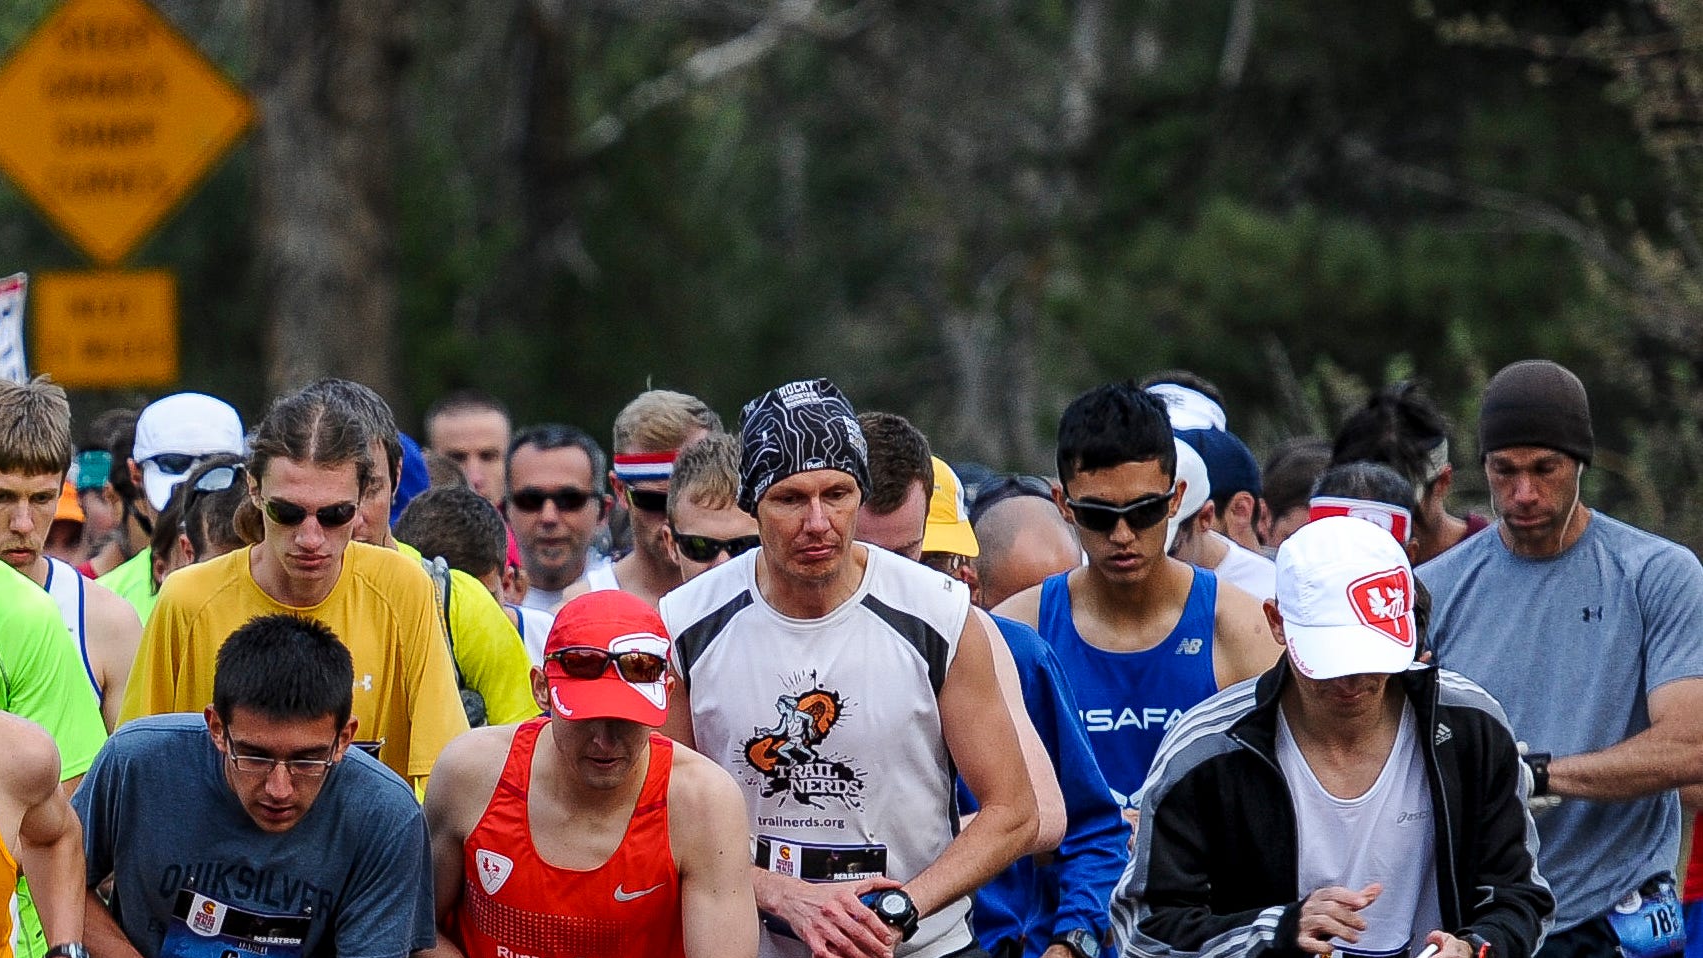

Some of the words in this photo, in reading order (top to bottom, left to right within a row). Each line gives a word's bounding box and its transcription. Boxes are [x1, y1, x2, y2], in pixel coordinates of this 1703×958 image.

[779, 381, 814, 398] ROCKY
[1175, 637, 1203, 655] NB
[774, 763, 839, 779] TRAIL
[789, 778, 860, 794] NERDS
[757, 816, 845, 829] trailnerds.org
[253, 935, 302, 945] MARATHON
